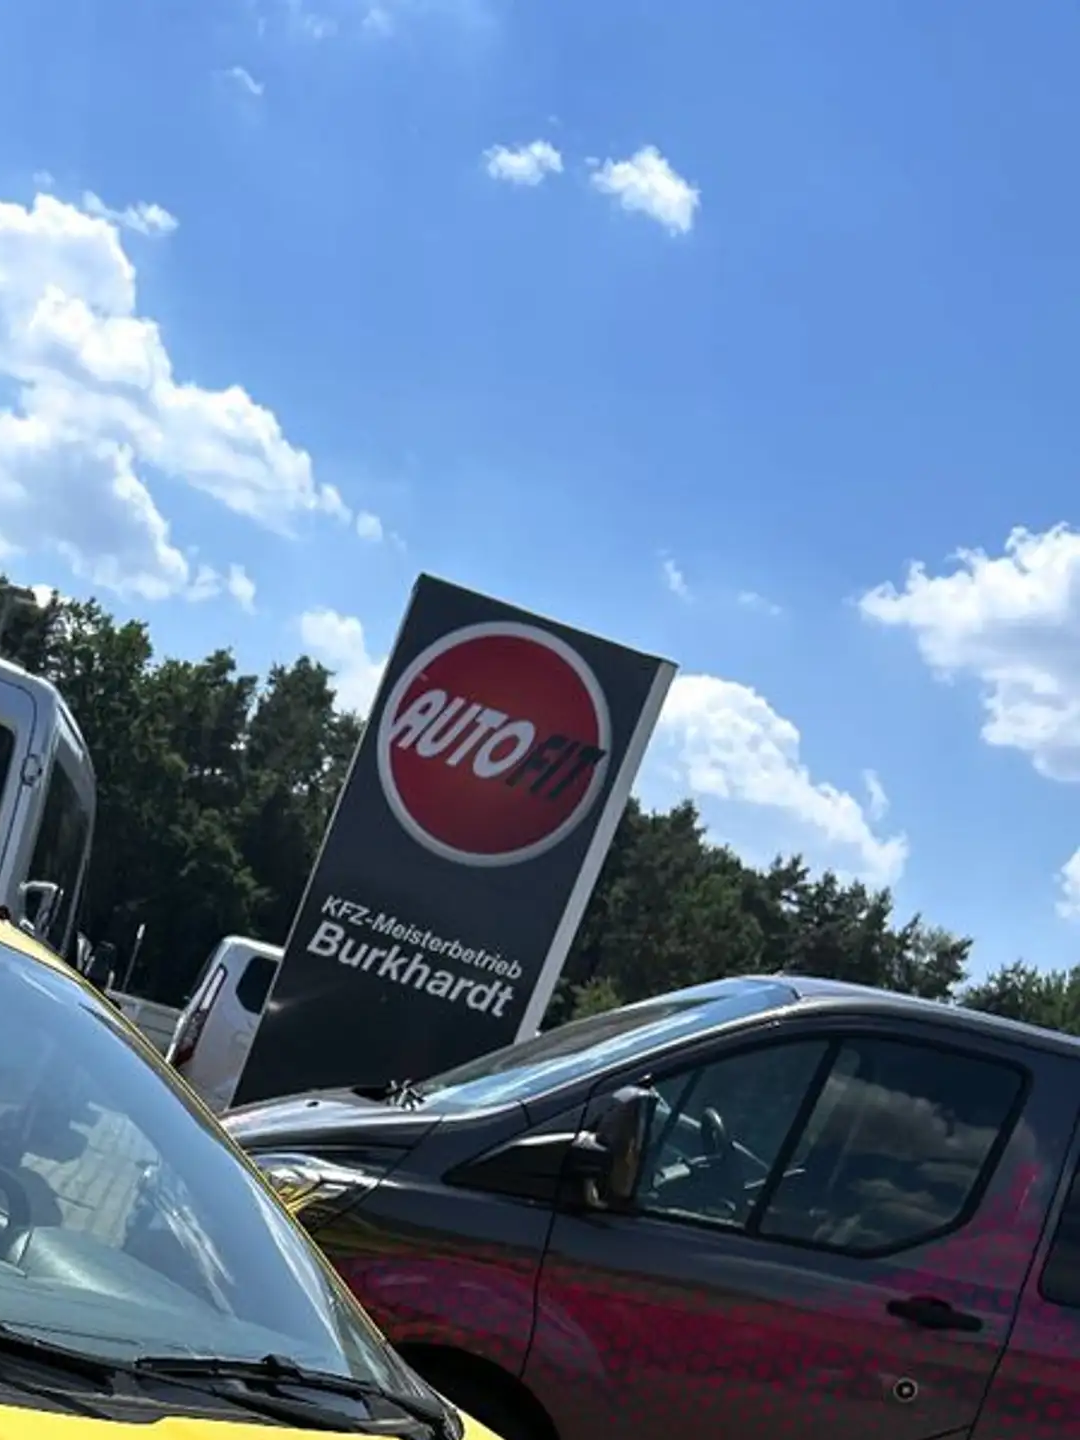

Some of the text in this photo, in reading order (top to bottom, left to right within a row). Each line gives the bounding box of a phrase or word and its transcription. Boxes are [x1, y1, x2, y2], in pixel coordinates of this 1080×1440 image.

[389, 688, 607, 799] AUTOFIT
[306, 919, 515, 1018] Burkhardt
[321, 894, 523, 980] KFZ-Meisterbetrieb
